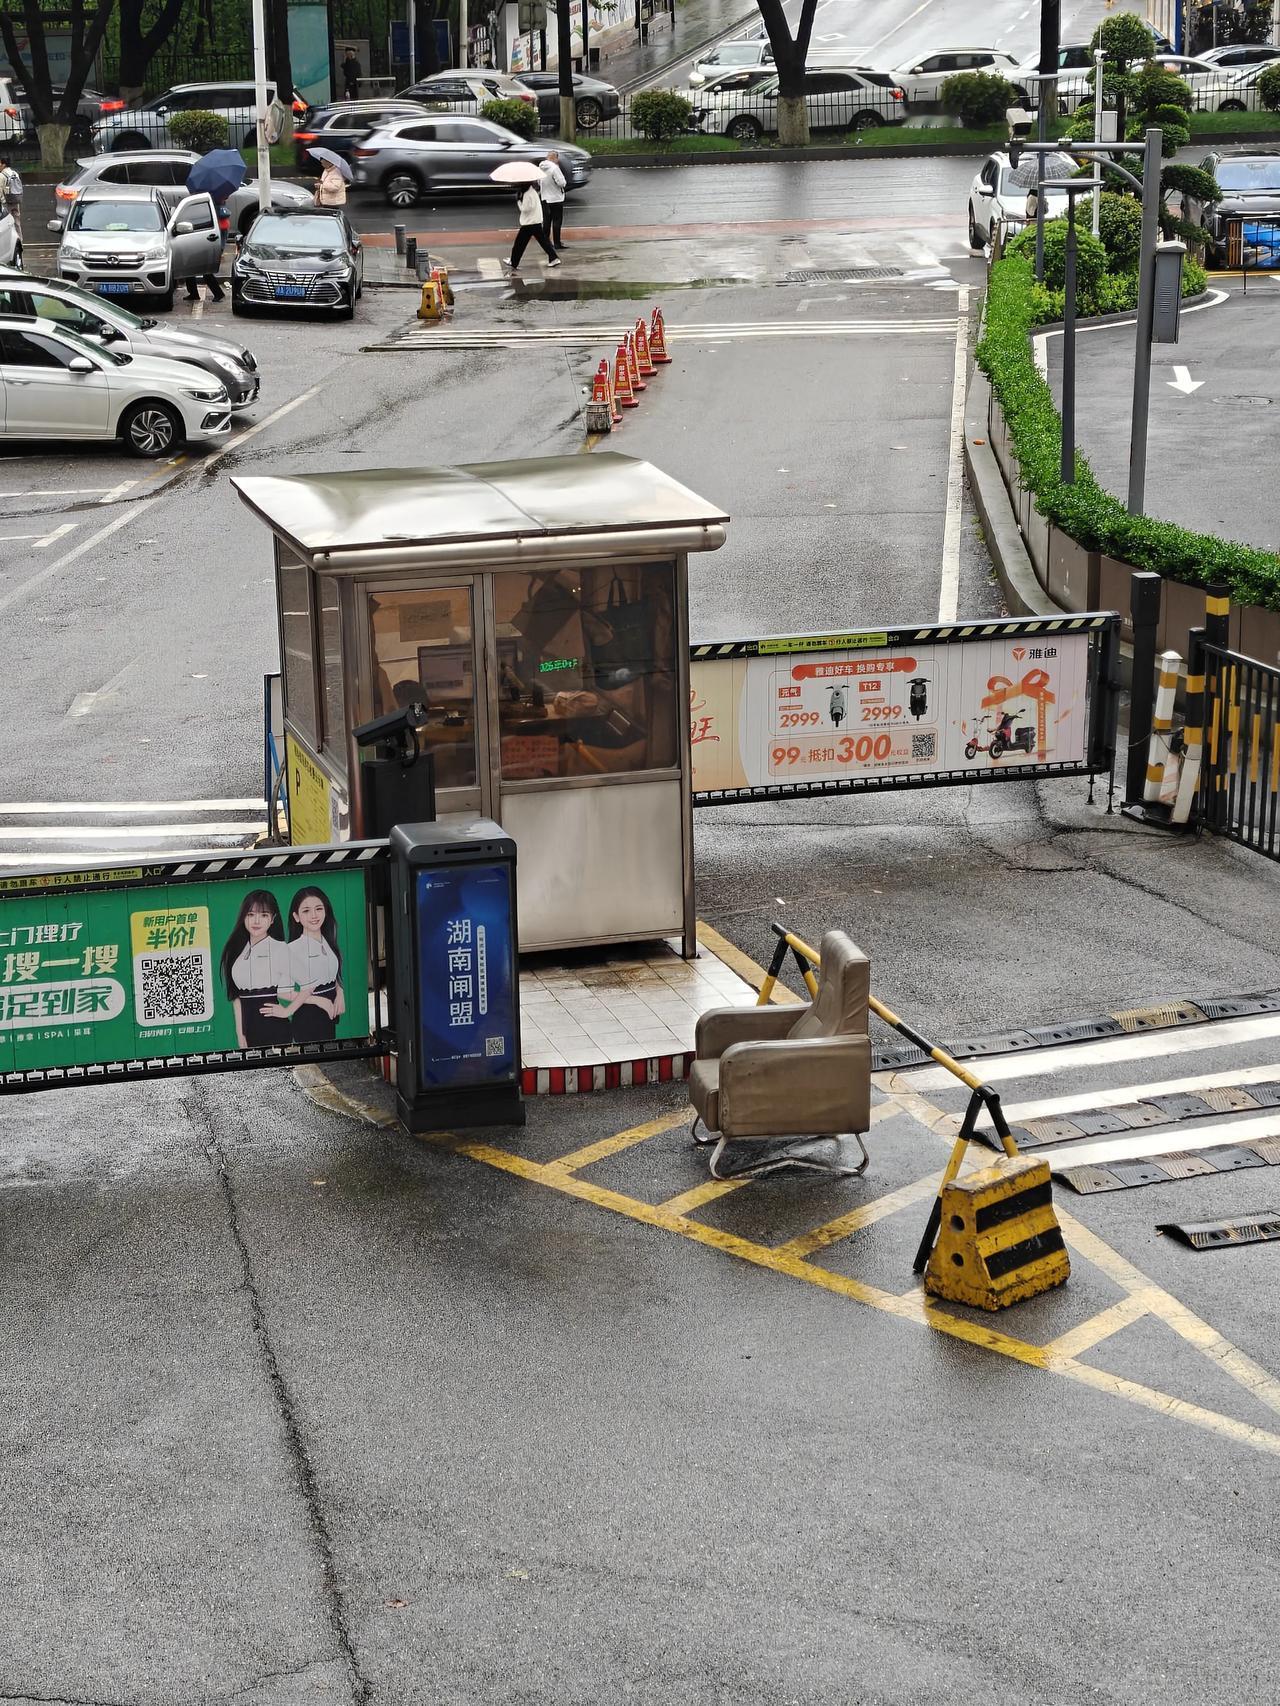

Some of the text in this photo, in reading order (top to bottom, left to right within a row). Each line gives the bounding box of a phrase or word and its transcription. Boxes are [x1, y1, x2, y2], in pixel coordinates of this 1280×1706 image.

[1028, 647, 1058, 660] 雅迪
[815, 661, 895, 677] 雅迪好车 换购专享
[780, 688, 799, 698] 元气
[863, 682, 877, 690] T12
[779, 711, 820, 728] 2999
[861, 704, 902, 722] 2999
[54, 872, 110, 884] 行人禁止通行
[144, 866, 162, 877] 入口
[142, 912, 198, 927] 新用户首单
[145, 926, 195, 949] 半价!
[2, 944, 119, 983] 搜一搜
[446, 918, 474, 1026] 湖南闸盟
[0, 985, 113, 1021] 足到家
[44, 1030, 64, 1039] SPA
